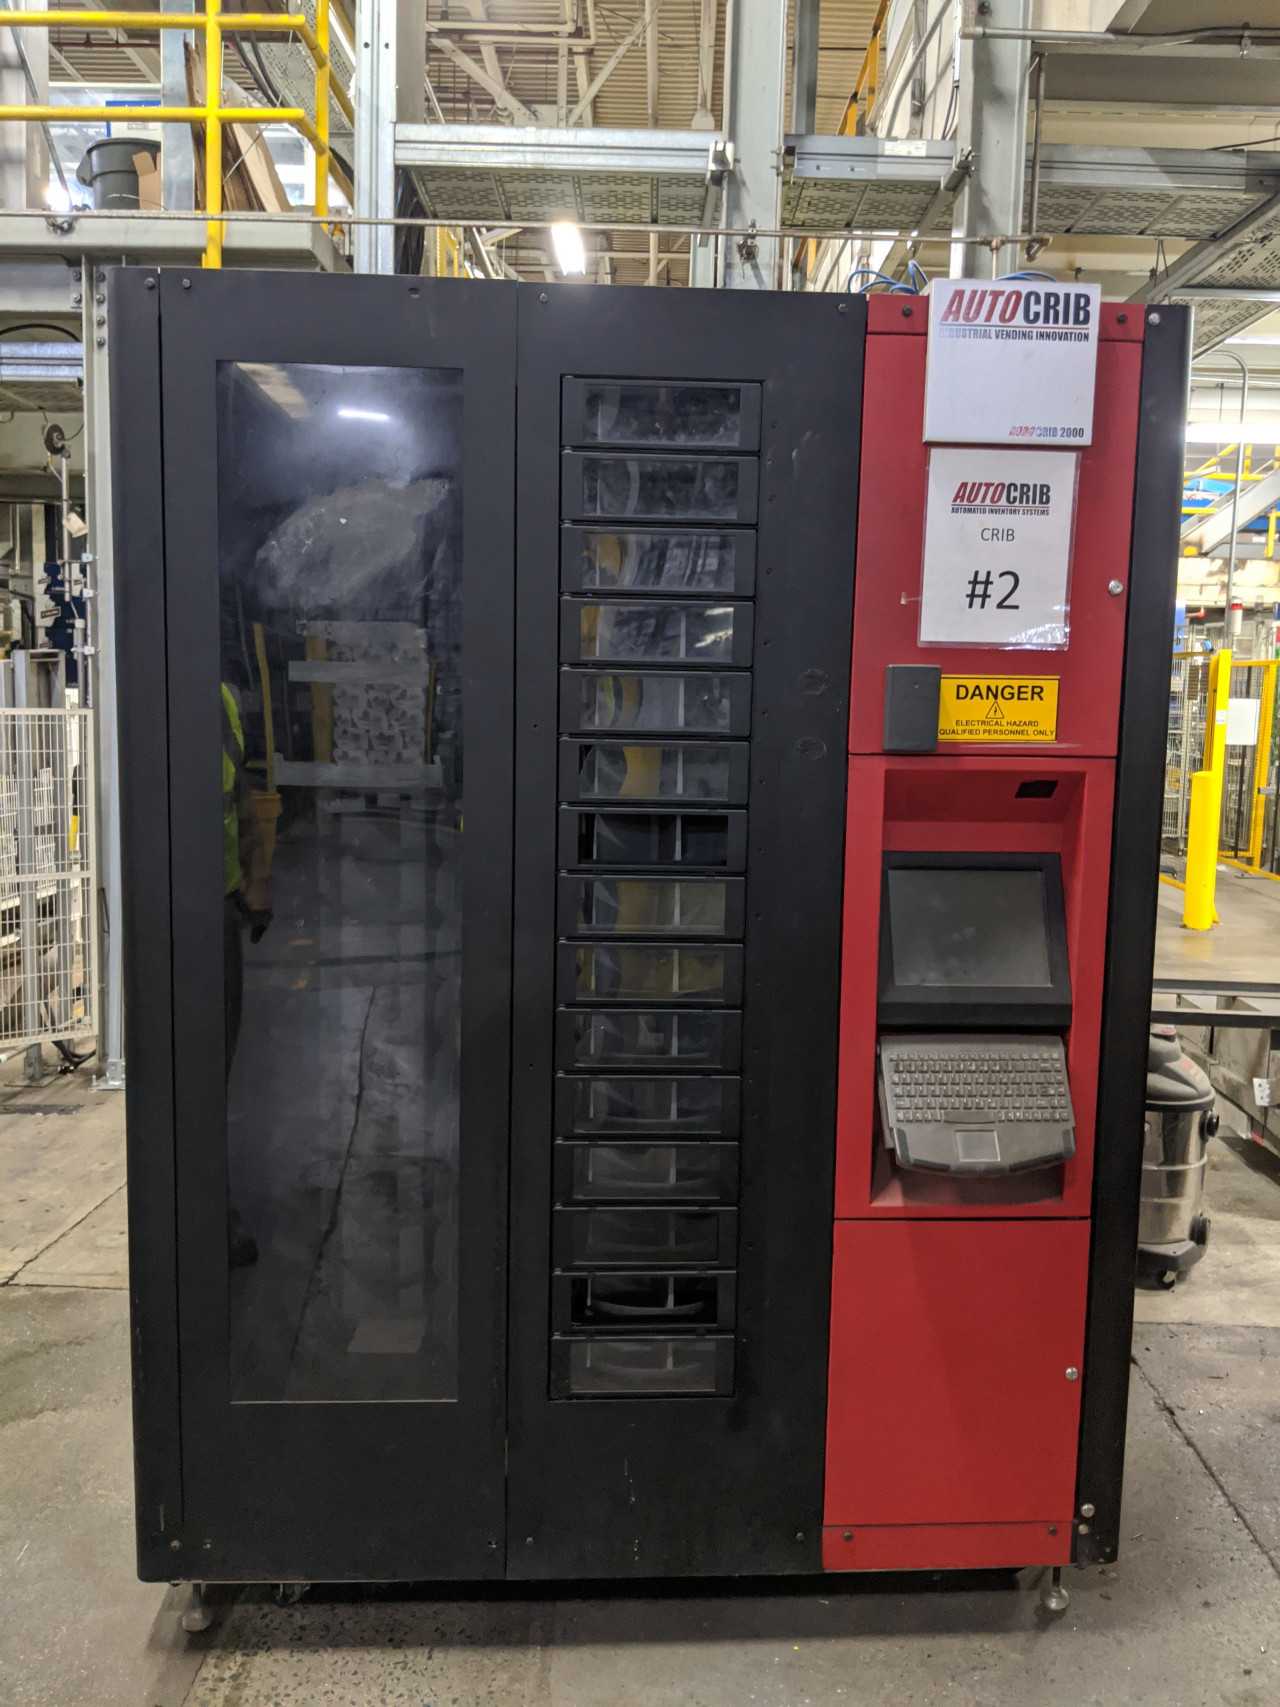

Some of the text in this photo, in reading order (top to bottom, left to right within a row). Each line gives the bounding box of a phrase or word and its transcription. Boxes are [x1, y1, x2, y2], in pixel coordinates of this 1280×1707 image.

[940, 288, 1091, 326] AUTOCRIB
[940, 327, 1090, 343] DUSTRIAL VENDING INNOVATION
[1059, 427, 1085, 439] 2000
[952, 481, 1051, 505] AUTOCRIB
[951, 506, 1050, 517] AUTOMATED INVENTORY SYSTEMS
[980, 527, 1015, 542] CRIB
[966, 569, 1020, 609] #2
[956, 684, 1044, 701] DANGER
[955, 719, 1039, 728] ELECTRICAL HAZARD
[939, 728, 1056, 737] QUALIFIED PERSONNEL ONLY
